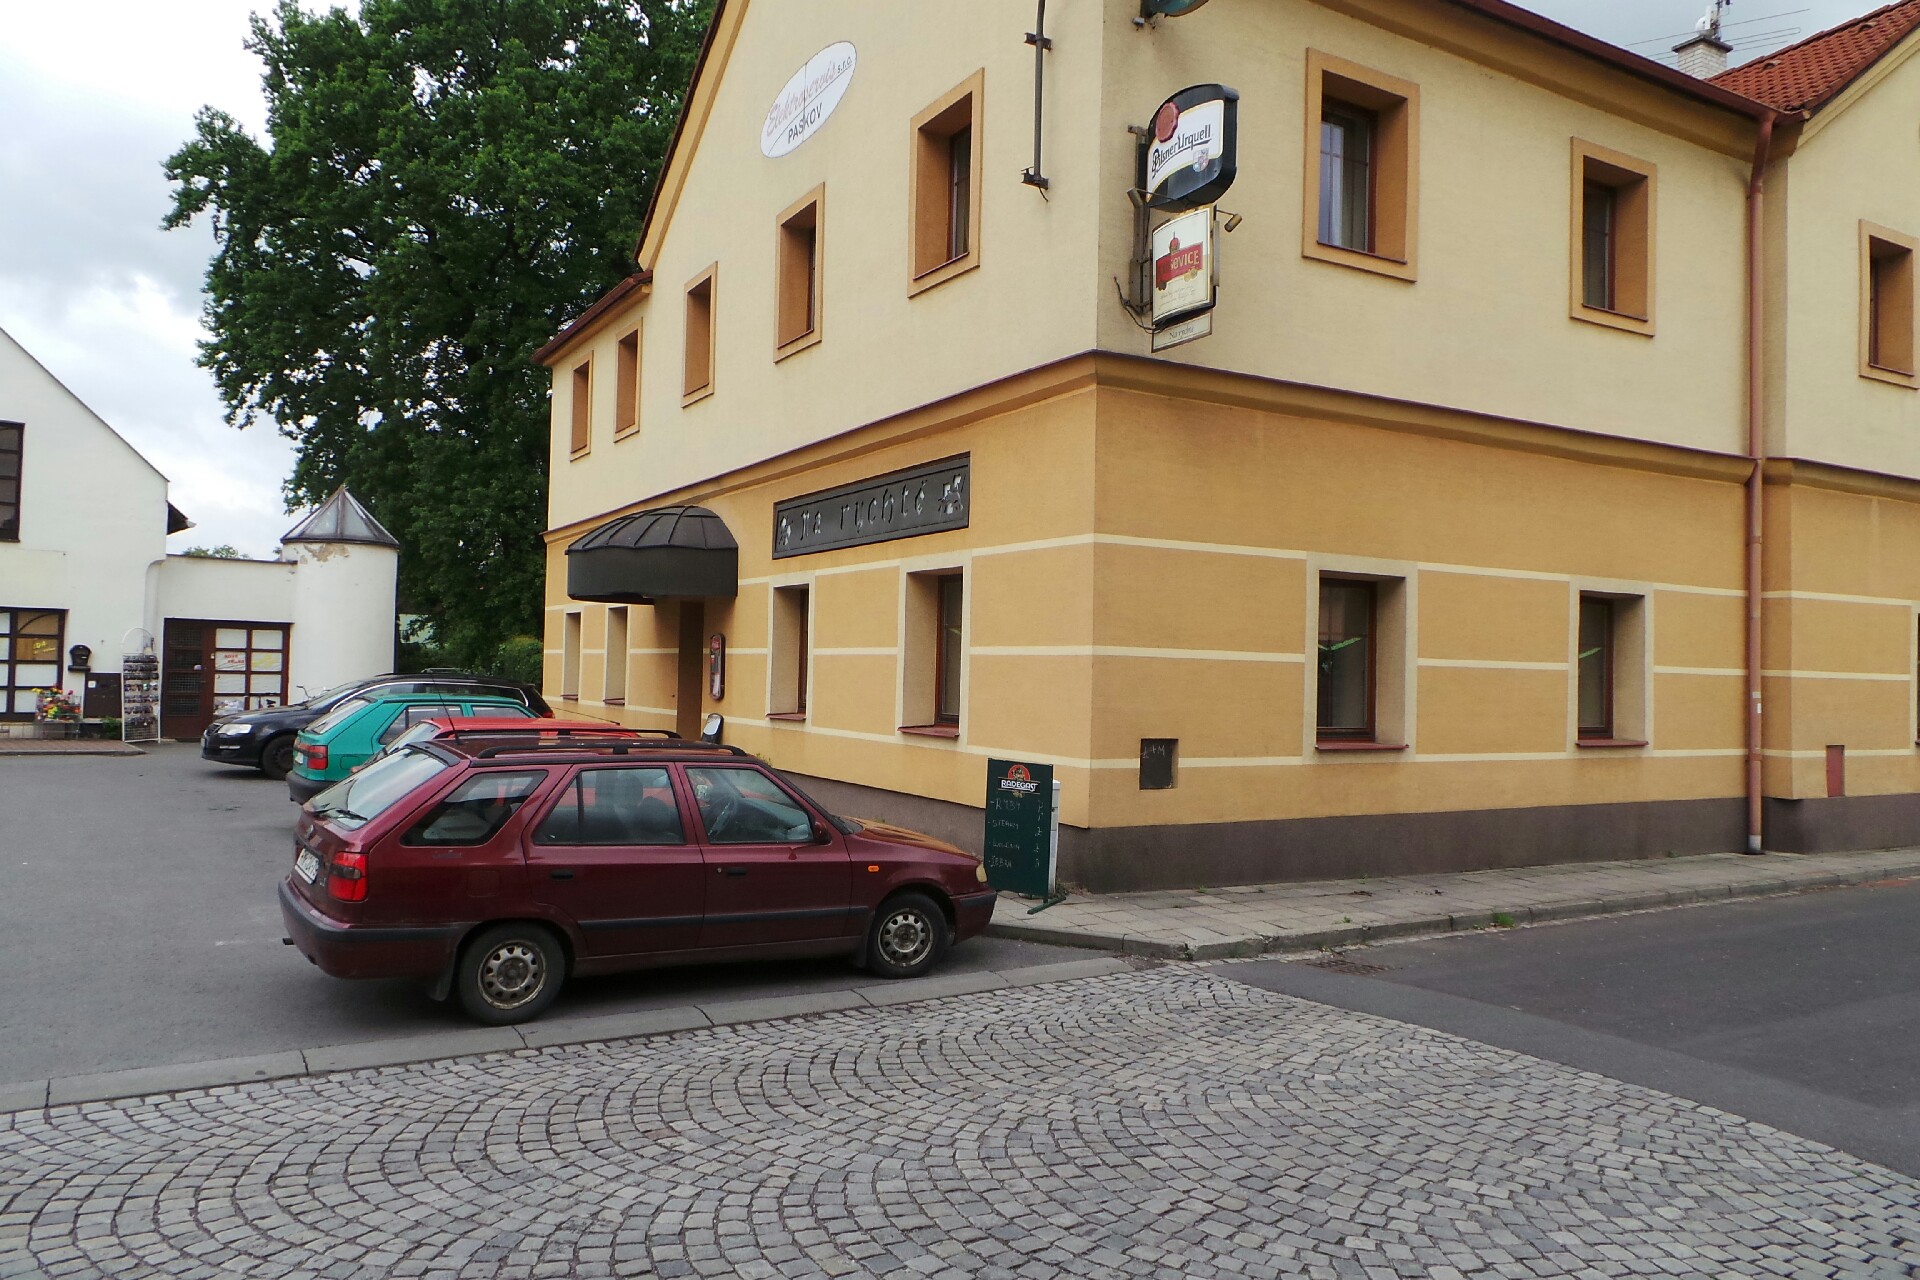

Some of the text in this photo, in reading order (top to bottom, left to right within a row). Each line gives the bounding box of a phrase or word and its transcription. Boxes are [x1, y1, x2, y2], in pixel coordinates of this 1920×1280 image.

[787, 102, 823, 144] PASKOV
[1151, 124, 1211, 180] Pilsner Urquell
[1001, 779, 1039, 792] RADEGAST
